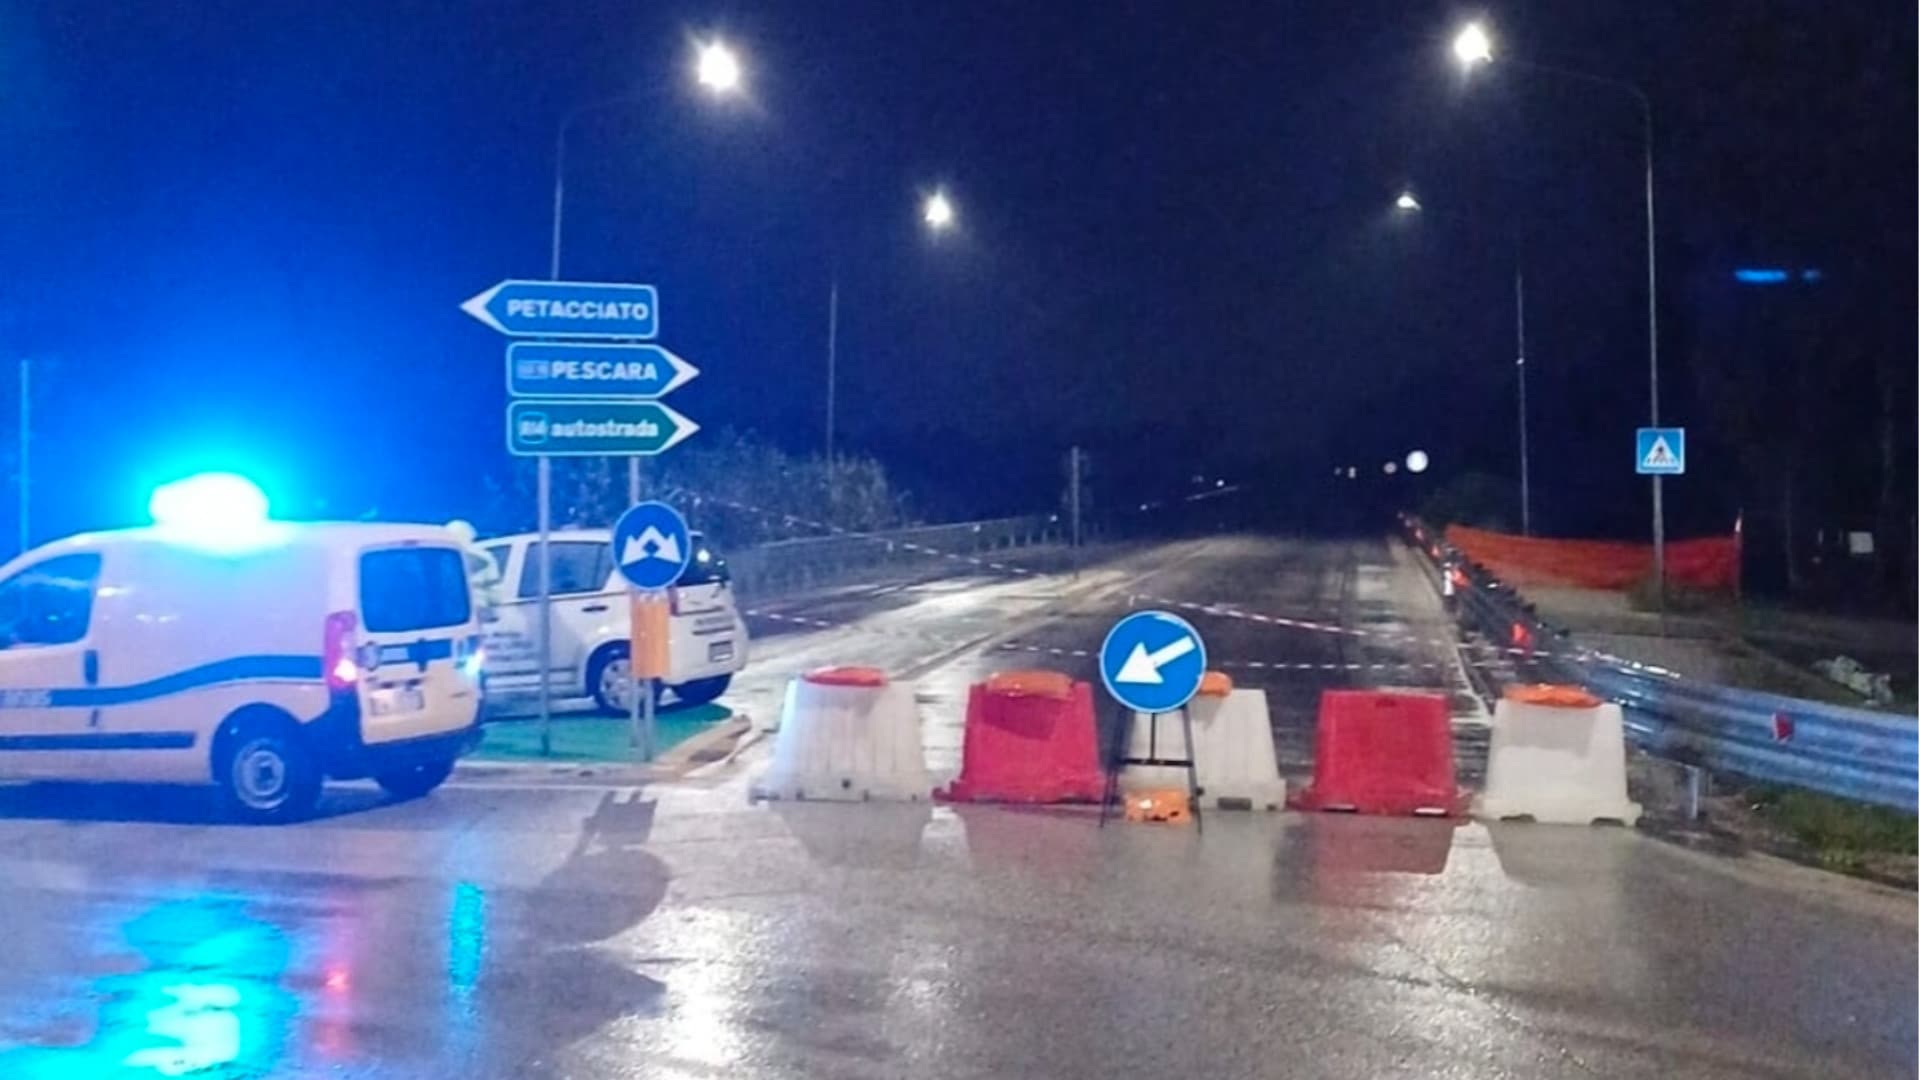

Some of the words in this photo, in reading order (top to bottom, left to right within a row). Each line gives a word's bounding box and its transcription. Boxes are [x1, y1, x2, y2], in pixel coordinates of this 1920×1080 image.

[507, 299, 649, 321] PETACCIATO
[551, 360, 658, 381] PESCARA
[551, 419, 658, 437] autostrada
